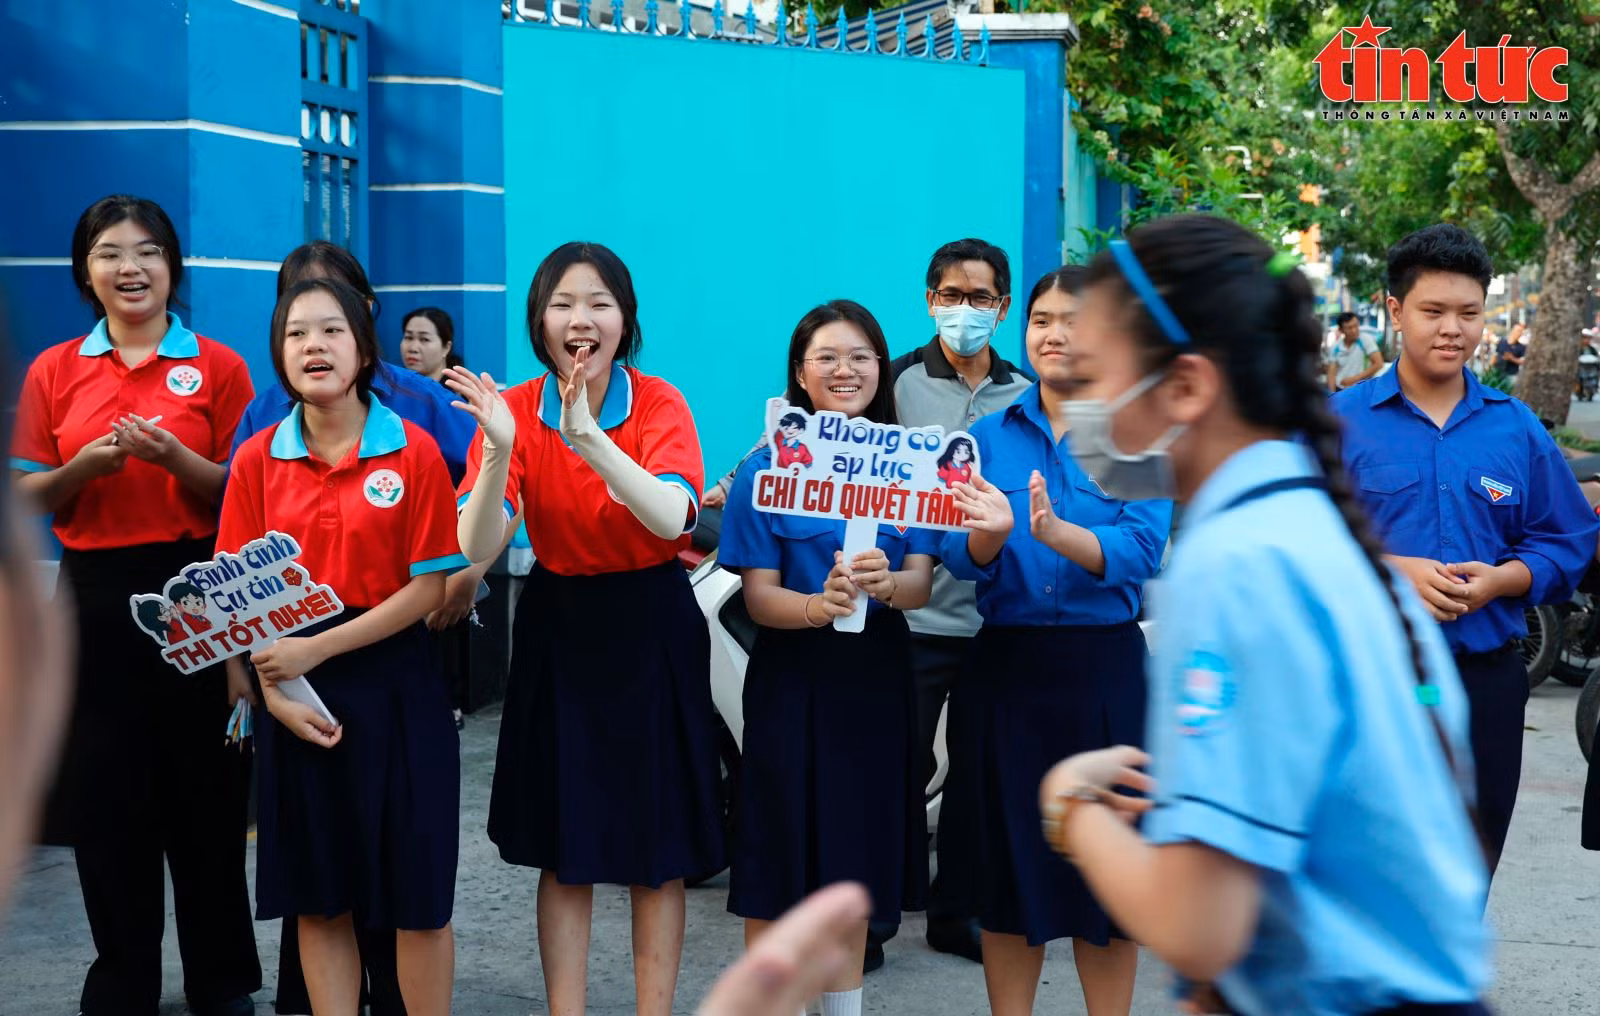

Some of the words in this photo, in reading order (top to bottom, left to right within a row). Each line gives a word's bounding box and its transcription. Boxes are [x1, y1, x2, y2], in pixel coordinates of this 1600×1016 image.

[818, 415, 901, 454] Không
[908, 430, 941, 452] có
[832, 452, 864, 481] áp
[757, 468, 799, 510] CHỈ
[802, 475, 834, 513] CÓ
[839, 480, 911, 520] QUYẾT
[916, 487, 970, 527] TÂM
[184, 556, 246, 591] Bình
[242, 535, 296, 569] tĩnh
[246, 575, 285, 600] tin
[166, 639, 217, 671] THI
[210, 612, 268, 653] TỐT
[268, 586, 338, 632] NHÉ!
